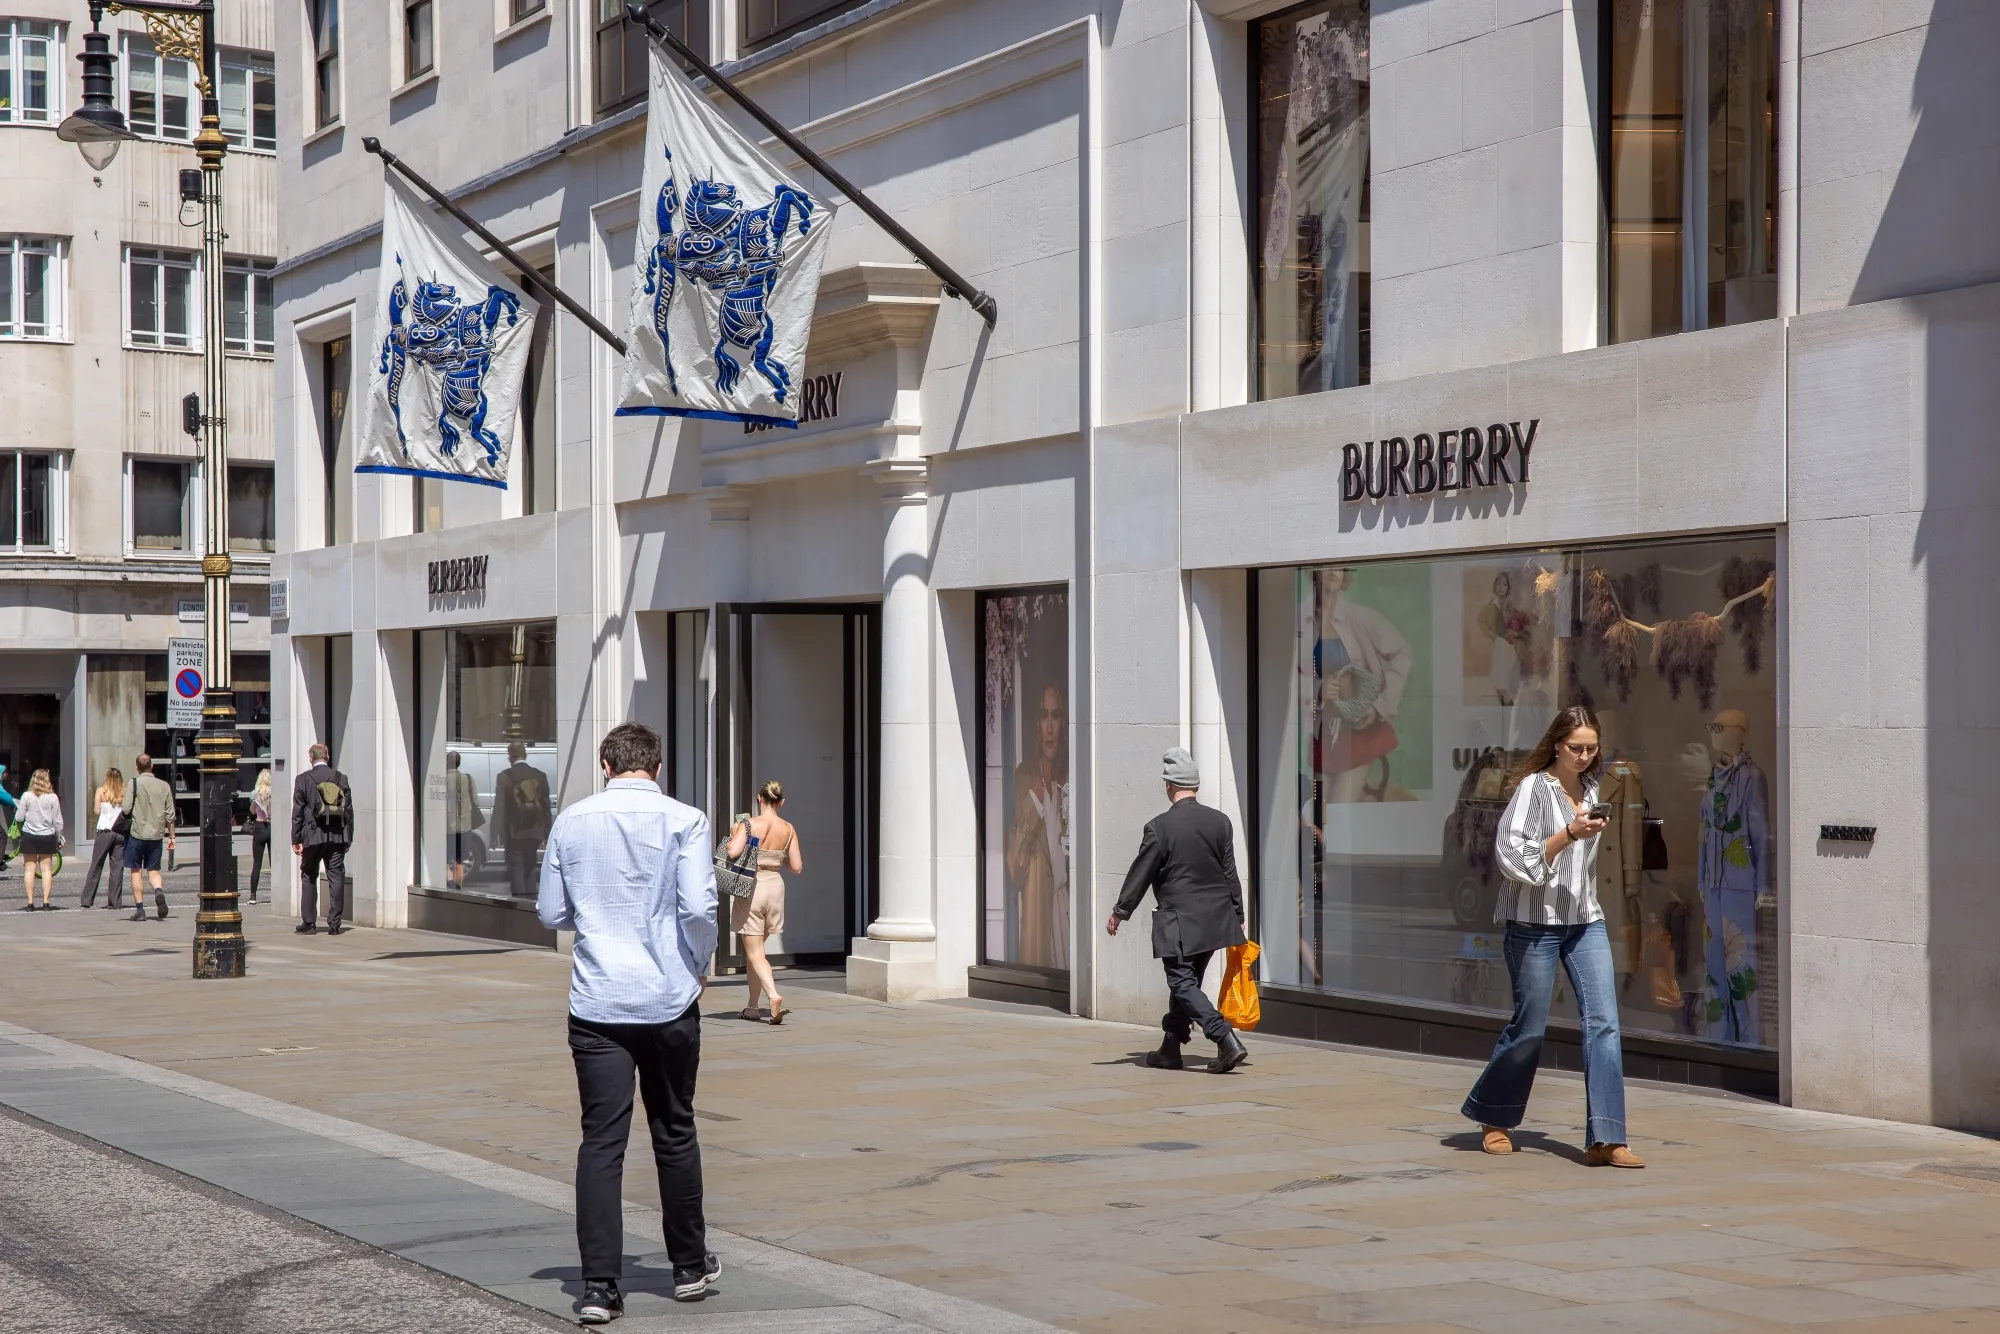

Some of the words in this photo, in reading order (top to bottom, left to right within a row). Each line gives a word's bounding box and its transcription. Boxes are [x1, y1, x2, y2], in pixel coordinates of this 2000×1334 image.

[1341, 418, 1541, 502] BURBERRY
[428, 554, 489, 595] BURBERRY
[182, 603, 204, 612] CONDU
[171, 640, 205, 649] Restricte
[176, 650, 203, 658] parking
[176, 658, 202, 667] ZONE
